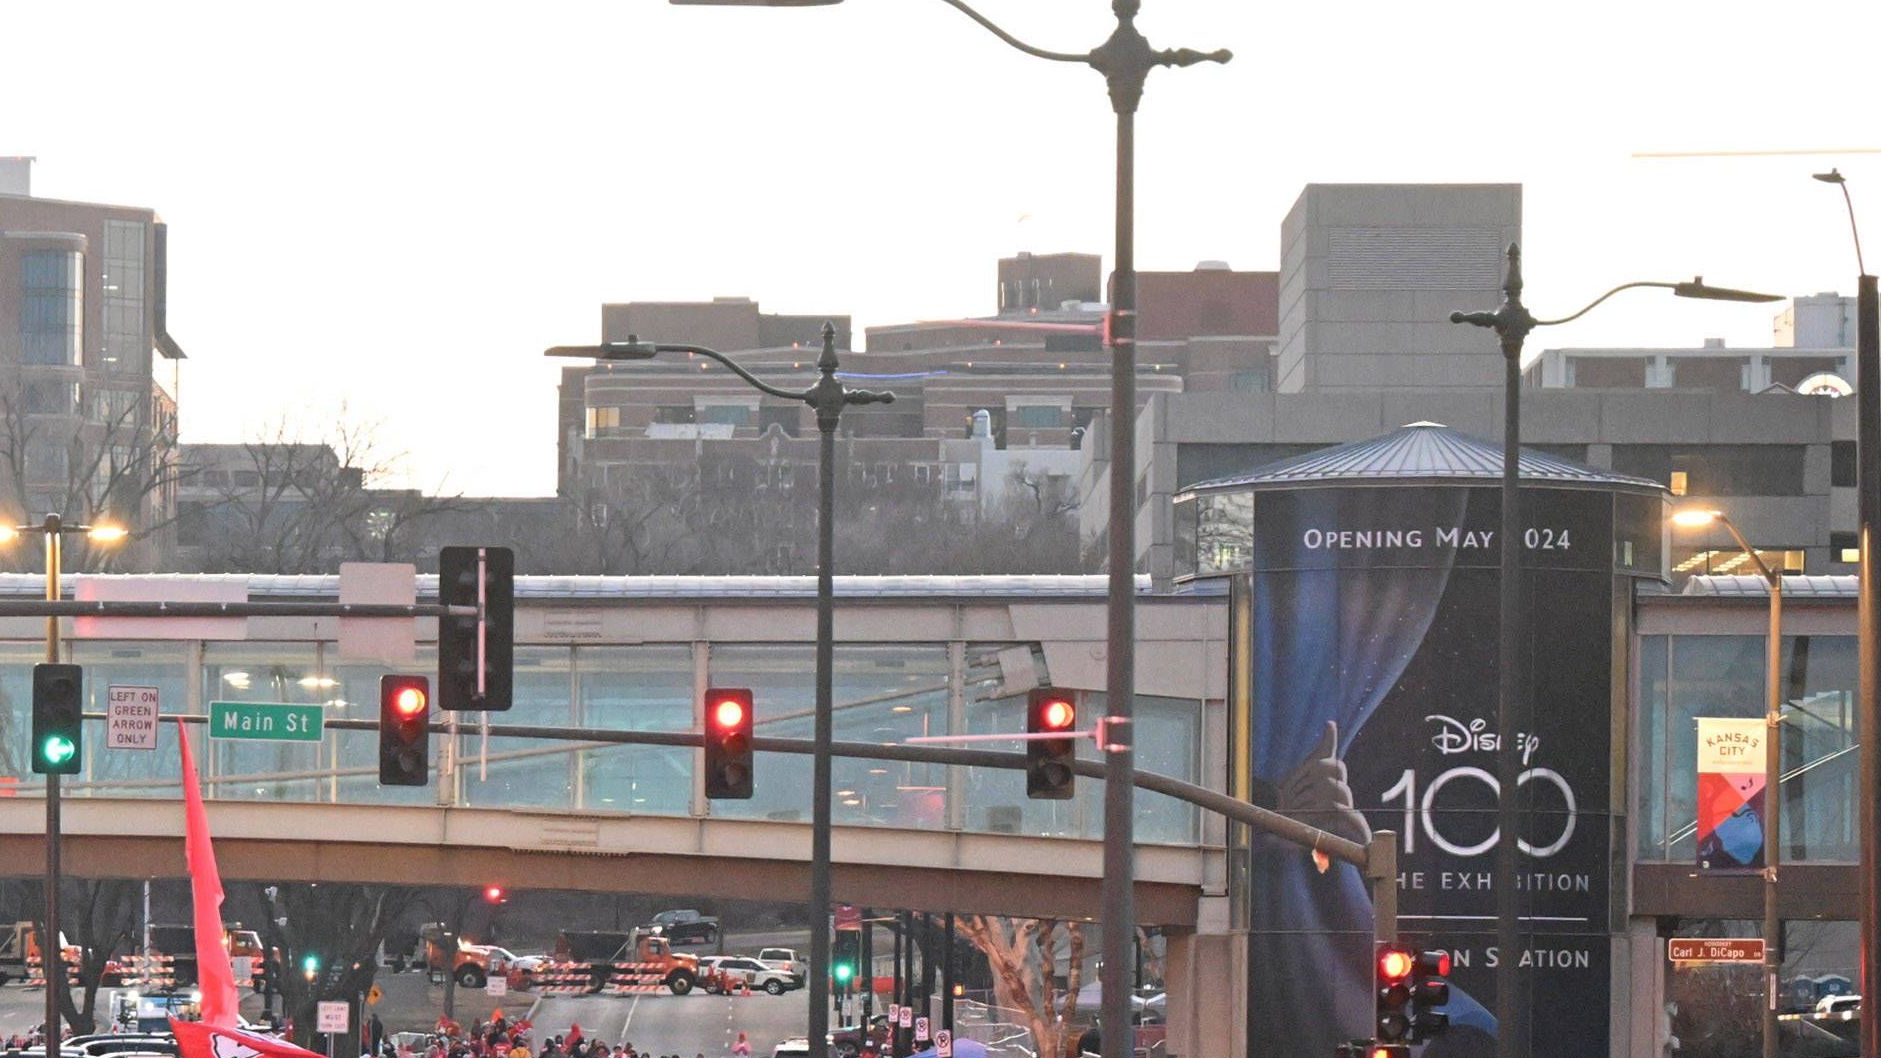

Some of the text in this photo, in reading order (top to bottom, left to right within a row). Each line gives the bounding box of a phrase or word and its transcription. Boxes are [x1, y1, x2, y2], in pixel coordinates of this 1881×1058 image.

[1524, 527, 1571, 550] 024
[110, 692, 157, 703] LEFT ON
[115, 706, 152, 717] GREEN
[112, 719, 153, 731] ARROW
[224, 712, 309, 733] Main St
[116, 733, 147, 745] ONLY
[1425, 714, 1540, 765] Disey
[1706, 732, 1760, 749] KANSAS
[1719, 746, 1746, 756] CITY
[1382, 766, 1577, 857] 100
[1396, 872, 1590, 892] HE EXHITION
[1486, 947, 1590, 968] SATION
[1673, 947, 1693, 958] Carl
[1697, 948, 1706, 957] J.
[1710, 947, 1745, 960] DiCapo
